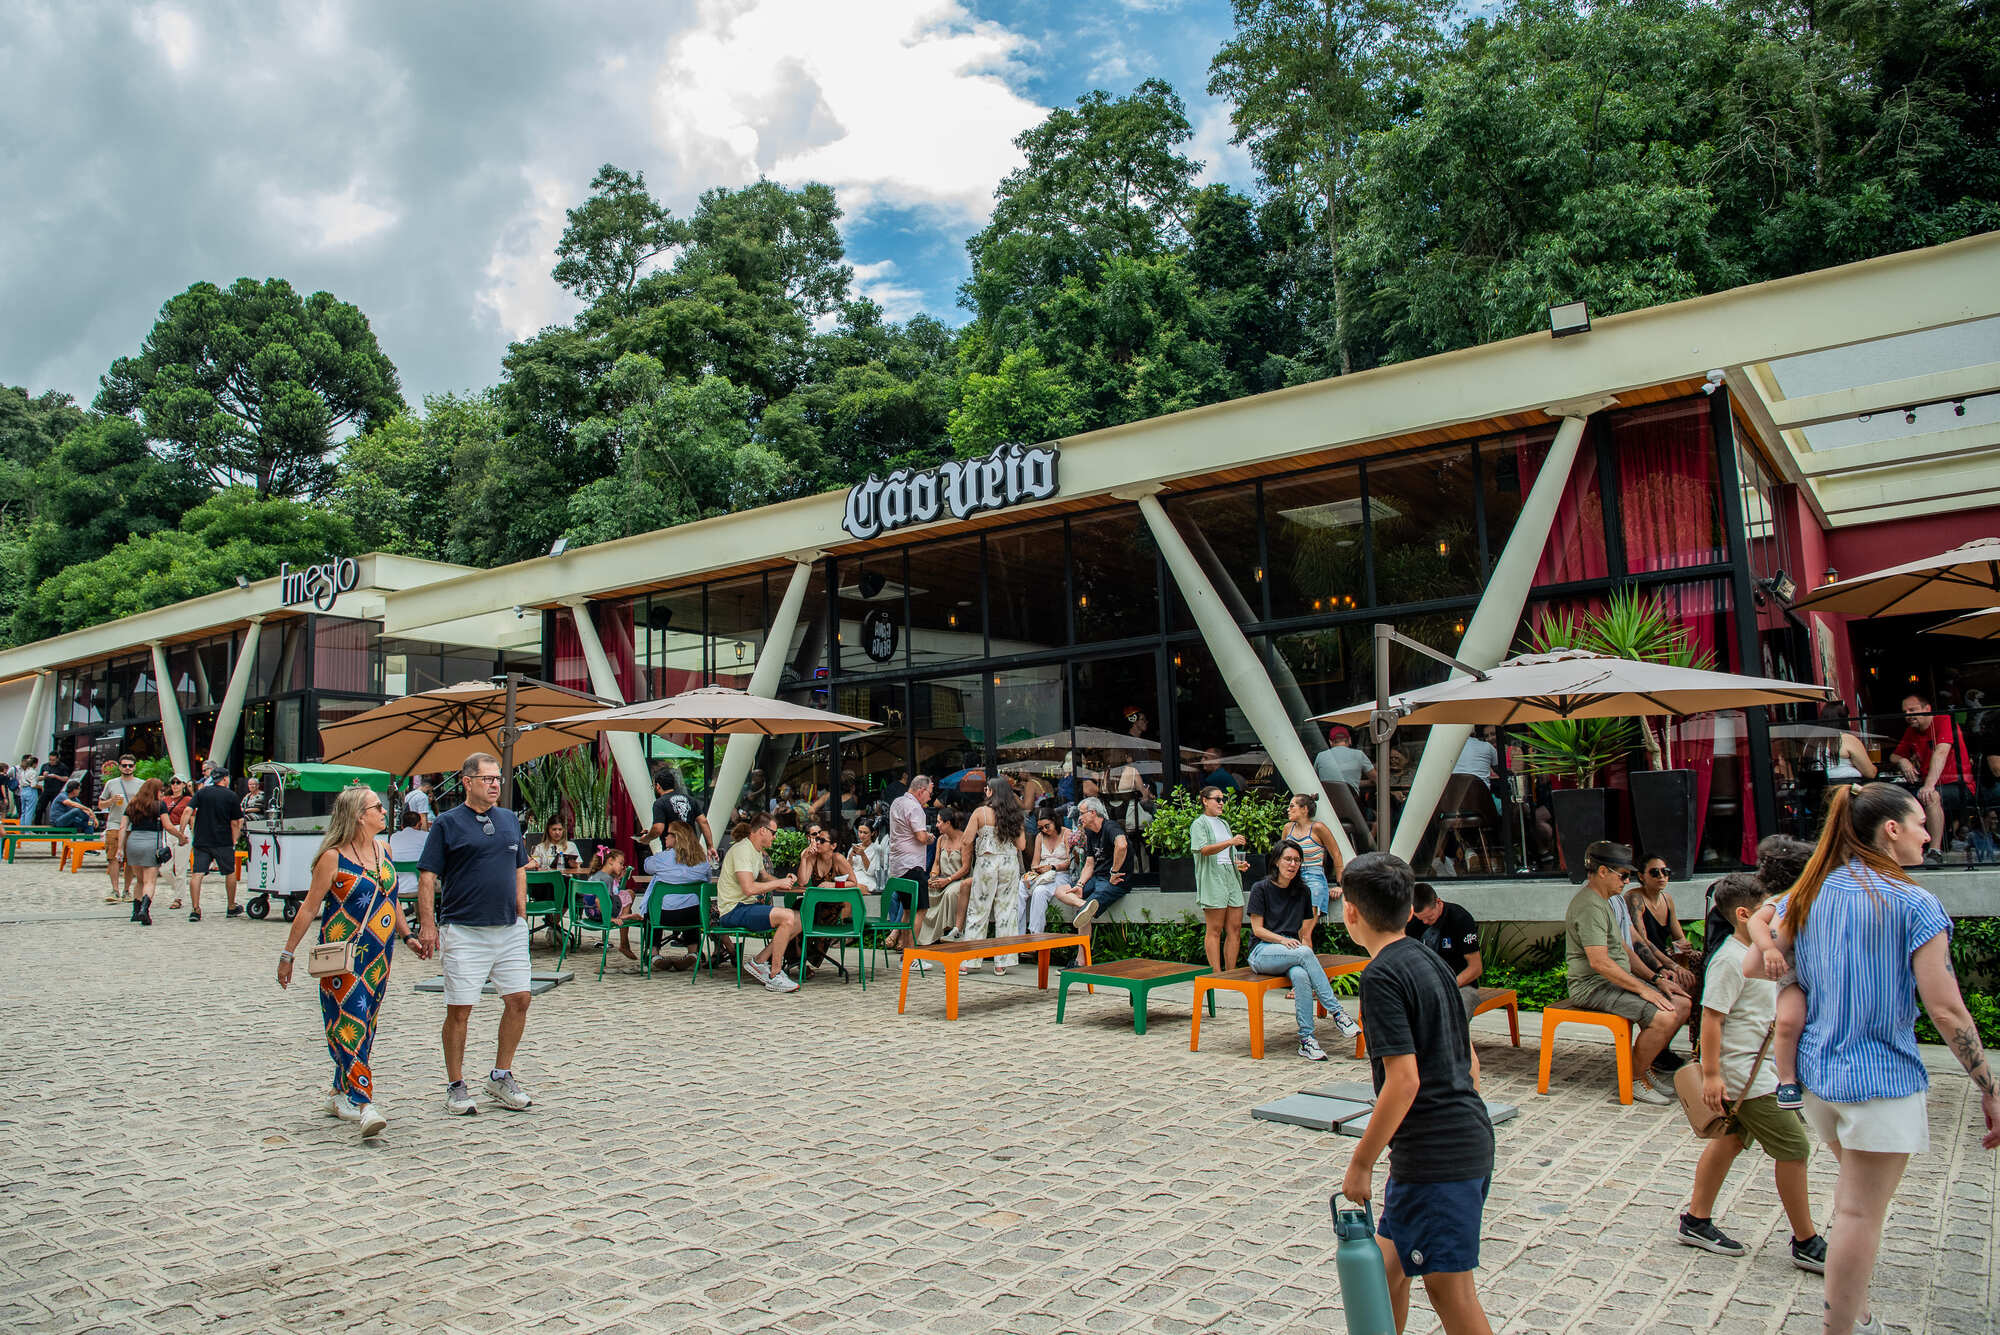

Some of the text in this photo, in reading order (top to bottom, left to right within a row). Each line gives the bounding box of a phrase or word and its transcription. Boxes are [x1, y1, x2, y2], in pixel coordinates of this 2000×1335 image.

[843, 442, 1060, 539] Cão Véio
[281, 556, 359, 611] Ernesto
